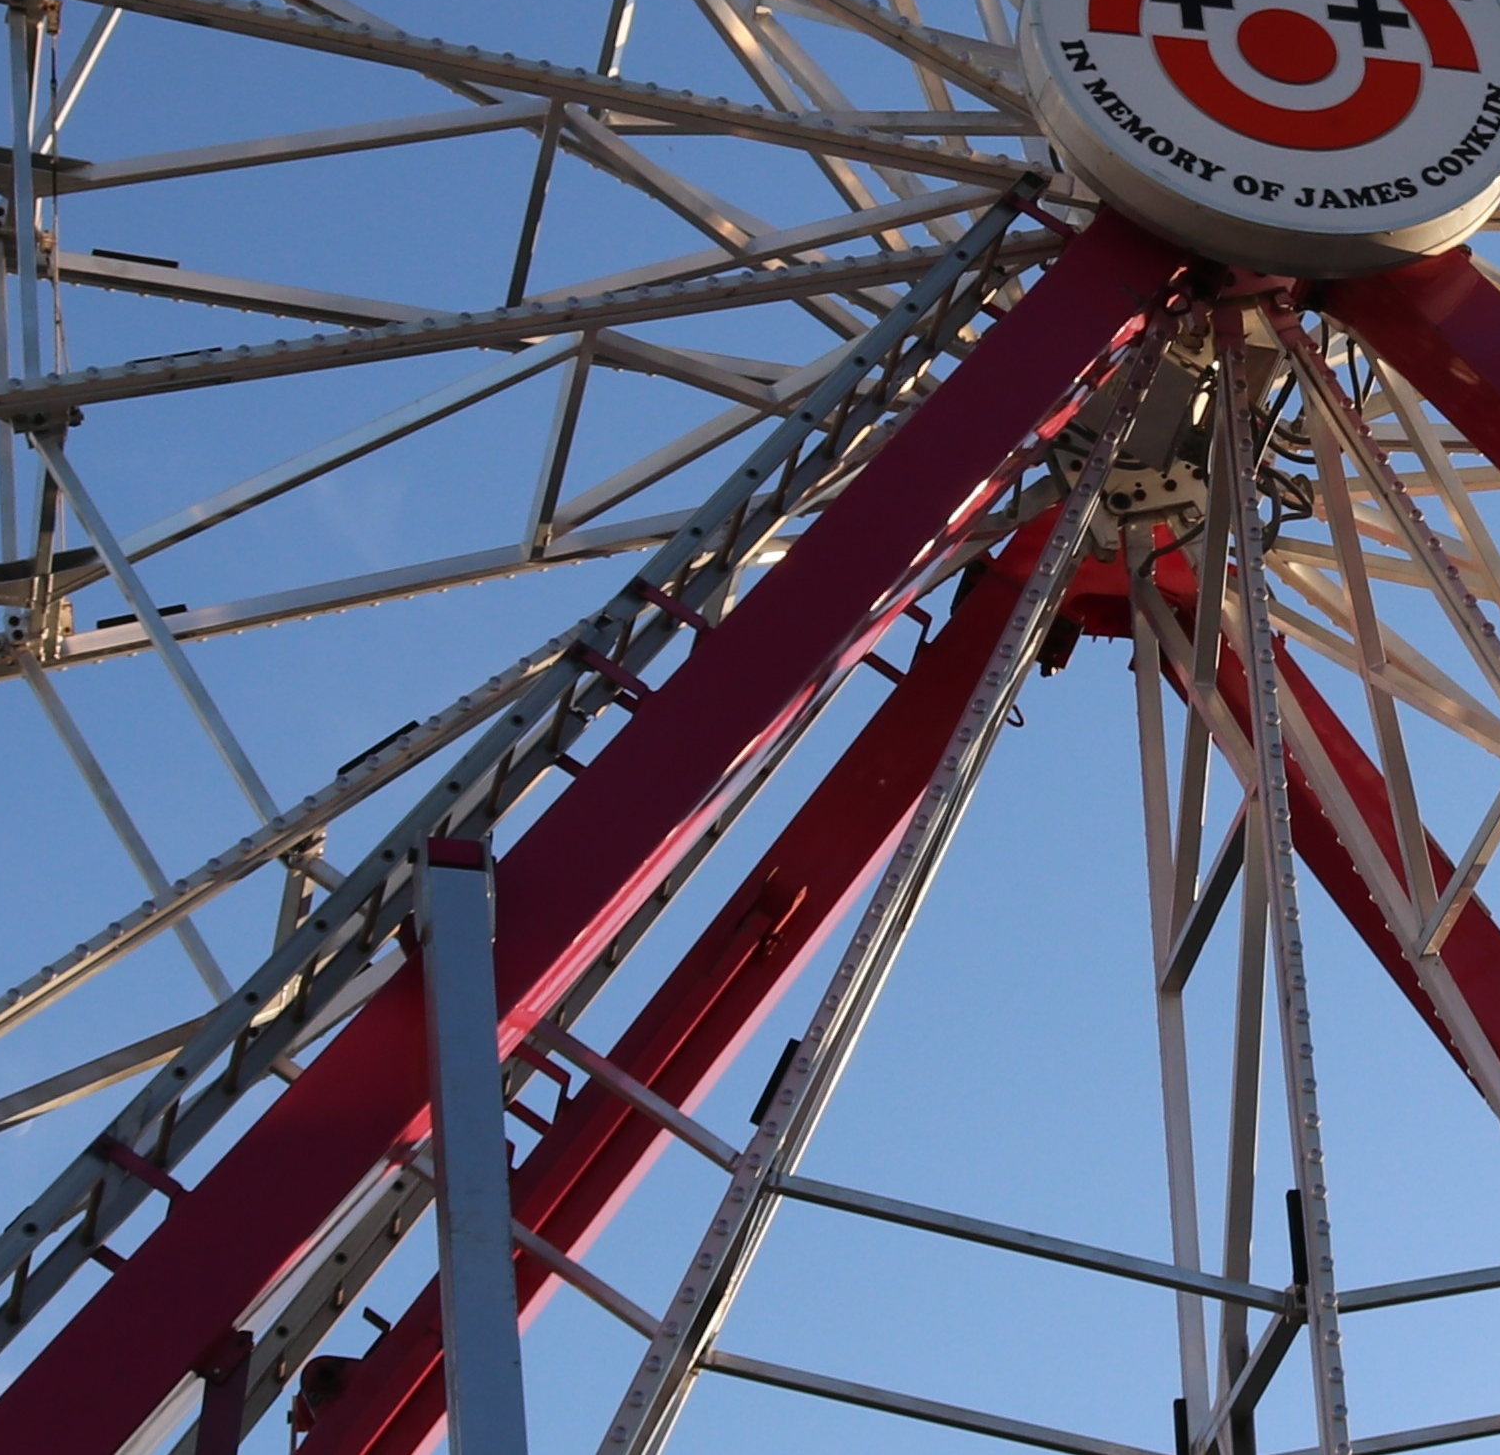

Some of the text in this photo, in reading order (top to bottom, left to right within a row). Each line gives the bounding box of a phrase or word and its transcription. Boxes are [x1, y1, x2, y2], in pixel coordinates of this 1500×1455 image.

[1060, 39, 1098, 73] IN
[1082, 75, 1226, 183] MEMORY
[1232, 173, 1285, 203] OF
[1294, 176, 1419, 210] JAMES
